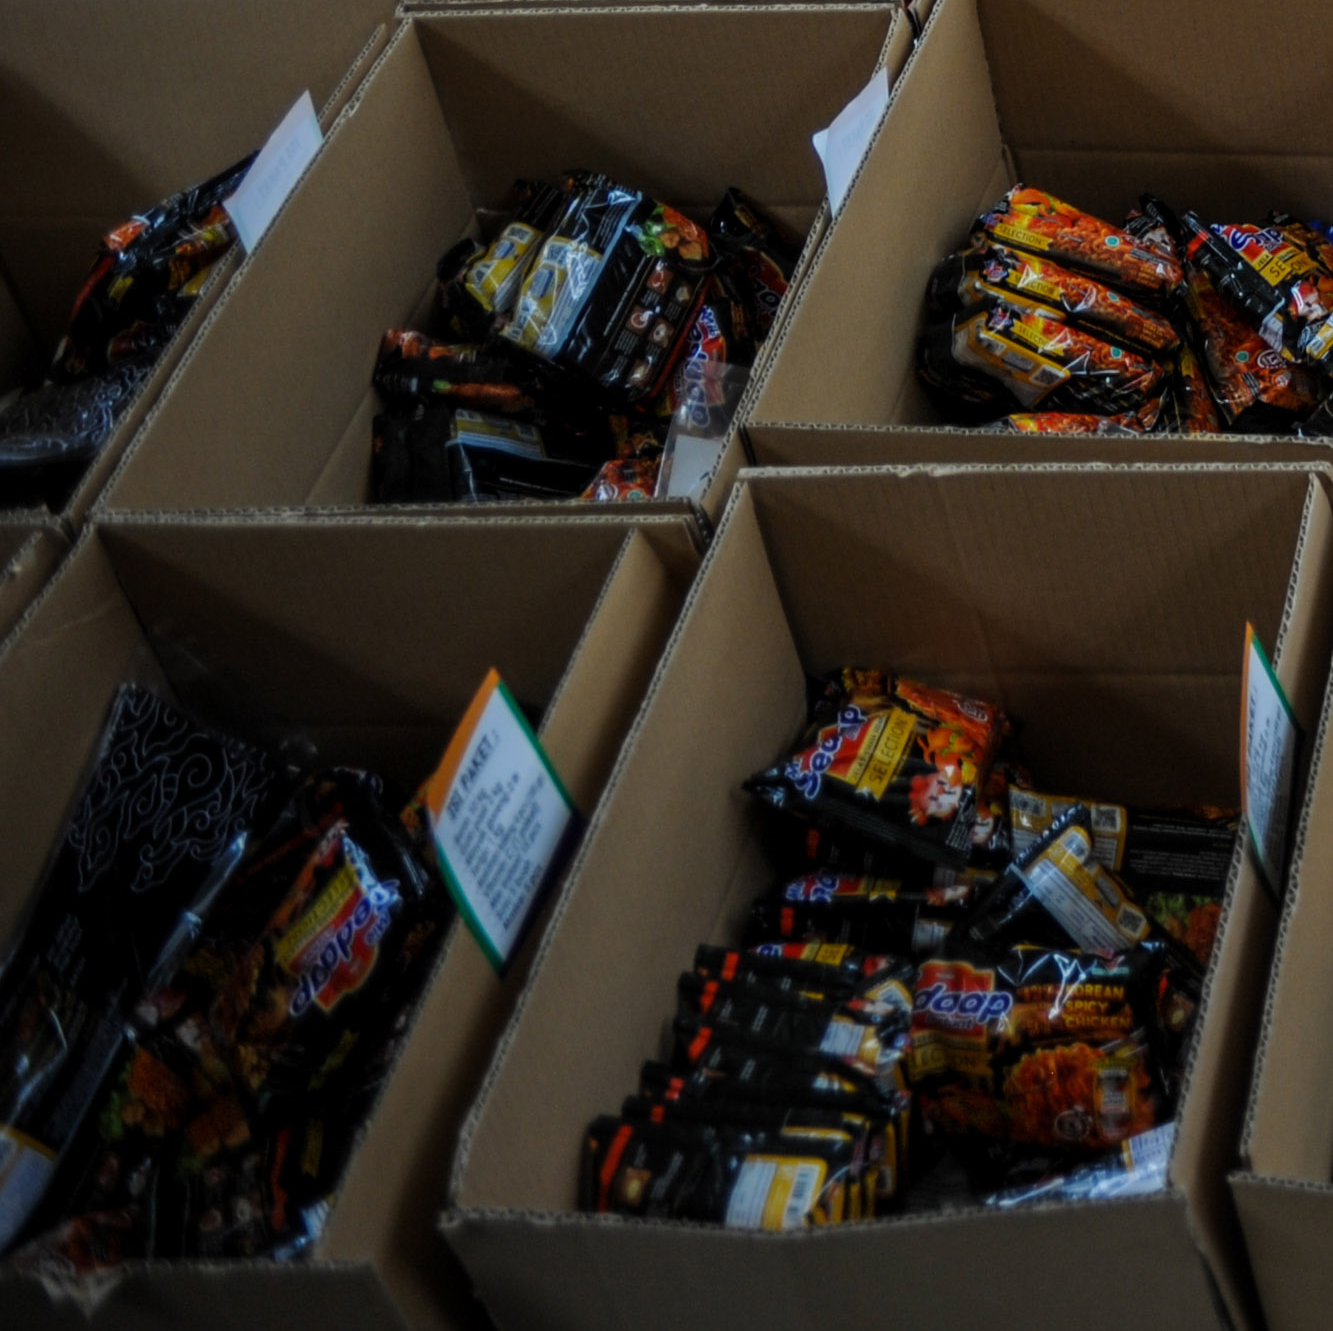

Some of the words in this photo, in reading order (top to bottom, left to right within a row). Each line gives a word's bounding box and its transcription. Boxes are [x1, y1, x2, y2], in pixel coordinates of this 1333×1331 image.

[460, 734, 493, 791] PAKET
[869, 719, 909, 784] SELECTION
[913, 982, 1014, 1024] daap
[1063, 1015, 1132, 1029] CHICKEN
[1065, 1000, 1110, 1013] SPICY
